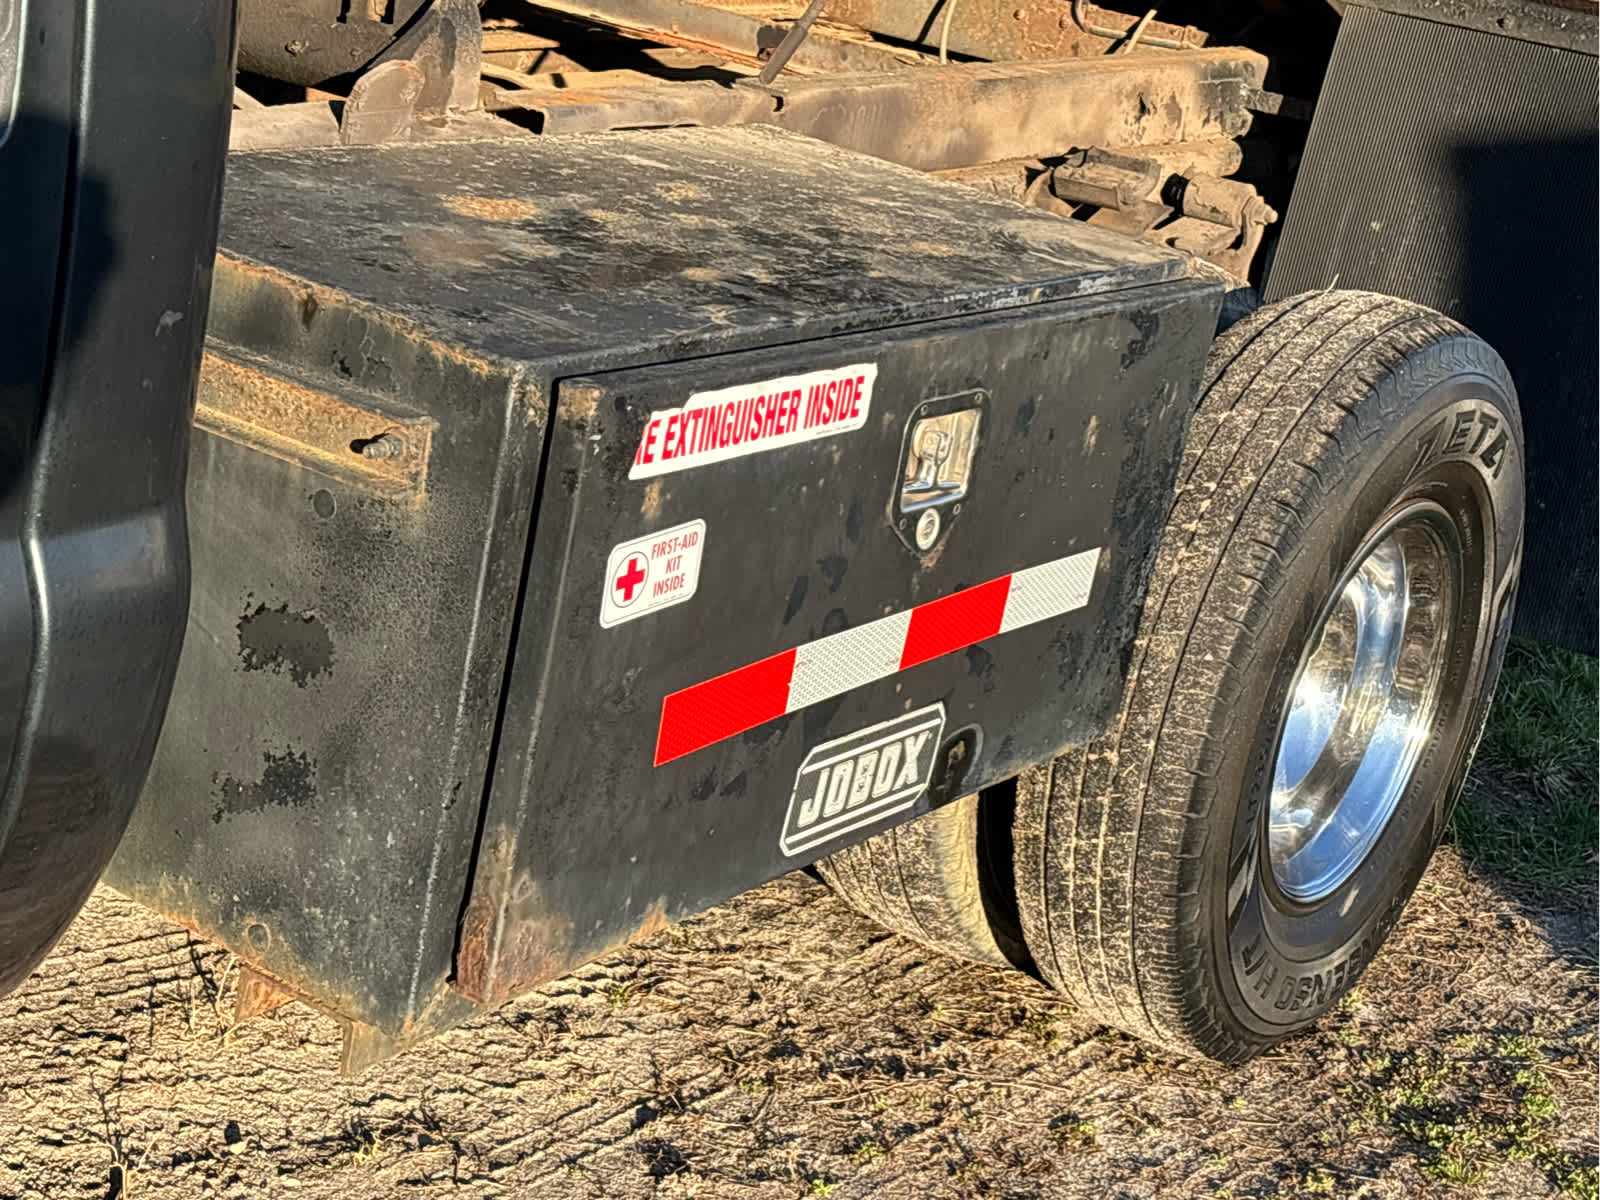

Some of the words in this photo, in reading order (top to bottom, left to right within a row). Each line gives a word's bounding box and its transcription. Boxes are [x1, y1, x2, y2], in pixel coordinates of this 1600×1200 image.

[661, 388, 802, 460] EXTINGUISHER
[803, 375, 865, 430] INSIDE
[1403, 408, 1509, 485] ZETA
[651, 531, 699, 560] FIRST-AID
[665, 555, 683, 574] KIT
[652, 572, 686, 598] INSIDE
[797, 730, 931, 828] JOBOX
